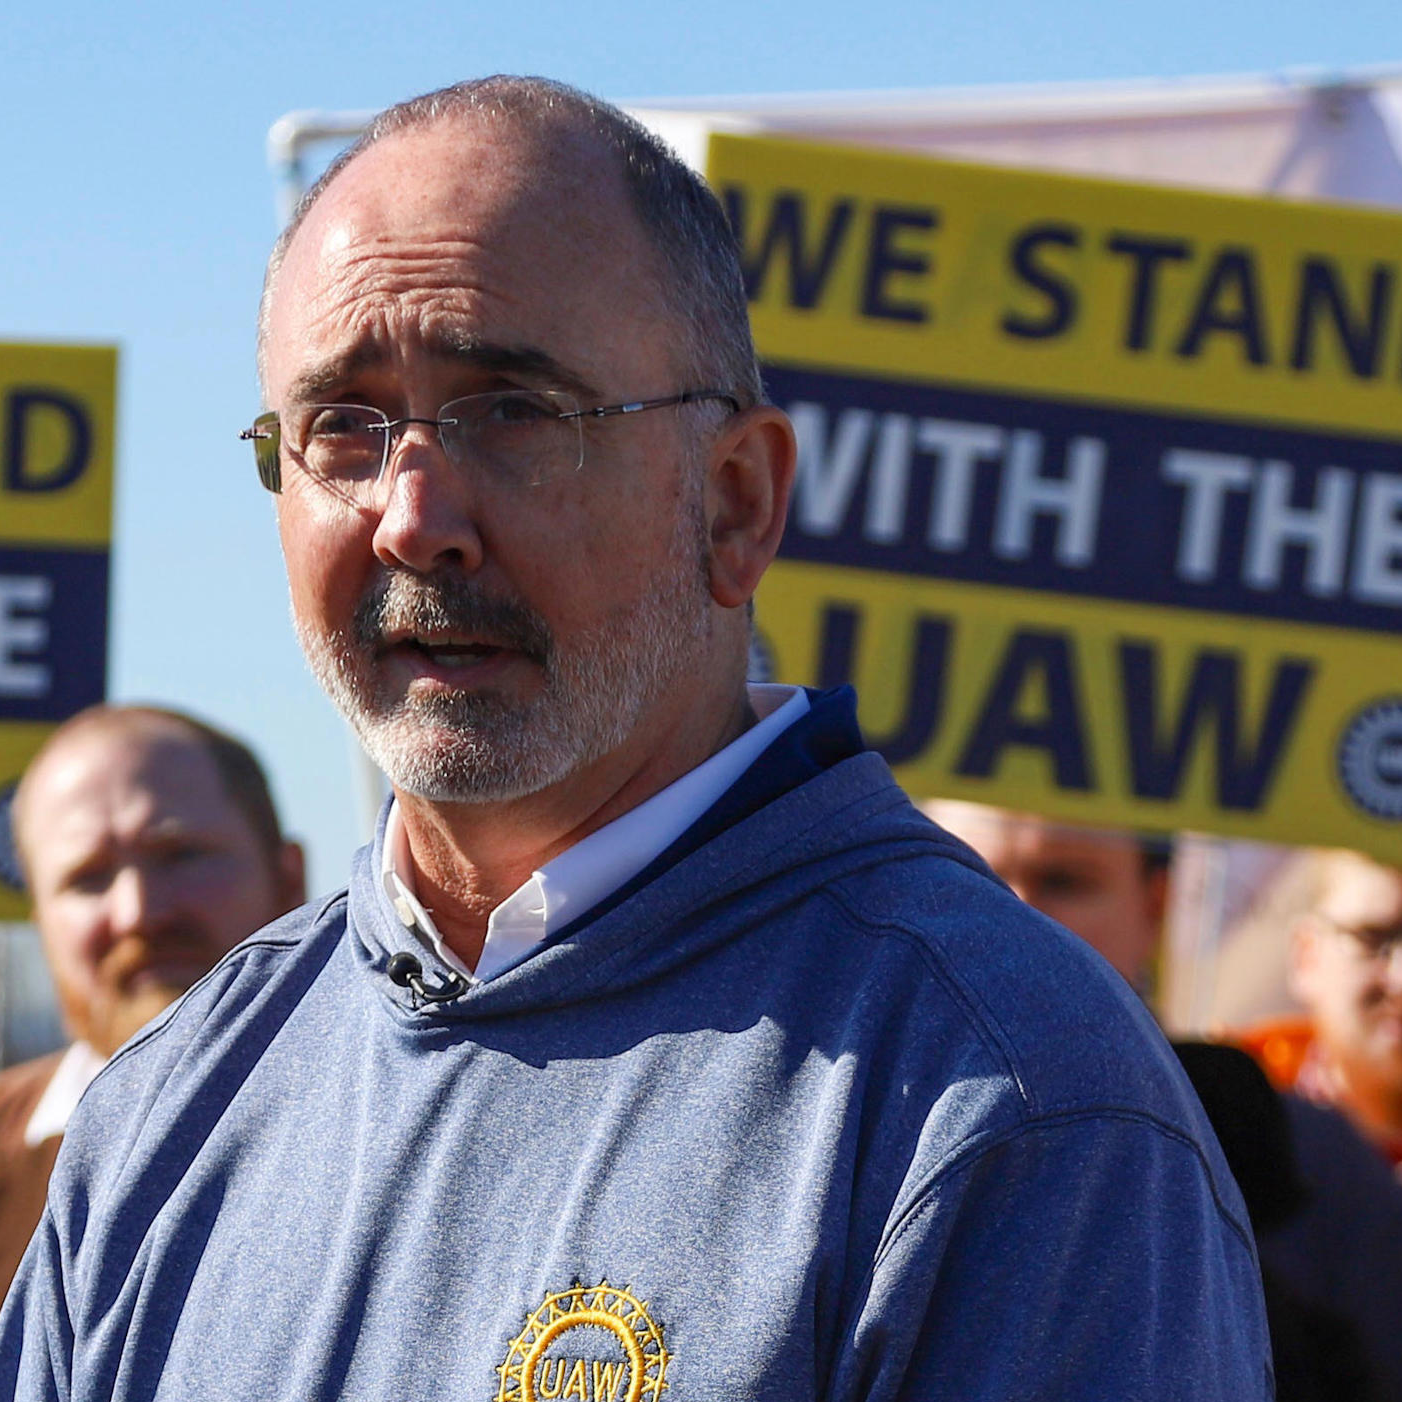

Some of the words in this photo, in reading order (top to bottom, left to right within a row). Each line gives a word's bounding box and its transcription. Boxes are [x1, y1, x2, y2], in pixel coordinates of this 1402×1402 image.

[722, 180, 940, 327] WE
[790, 400, 1108, 569] WITH
[816, 600, 1322, 817] UAW
